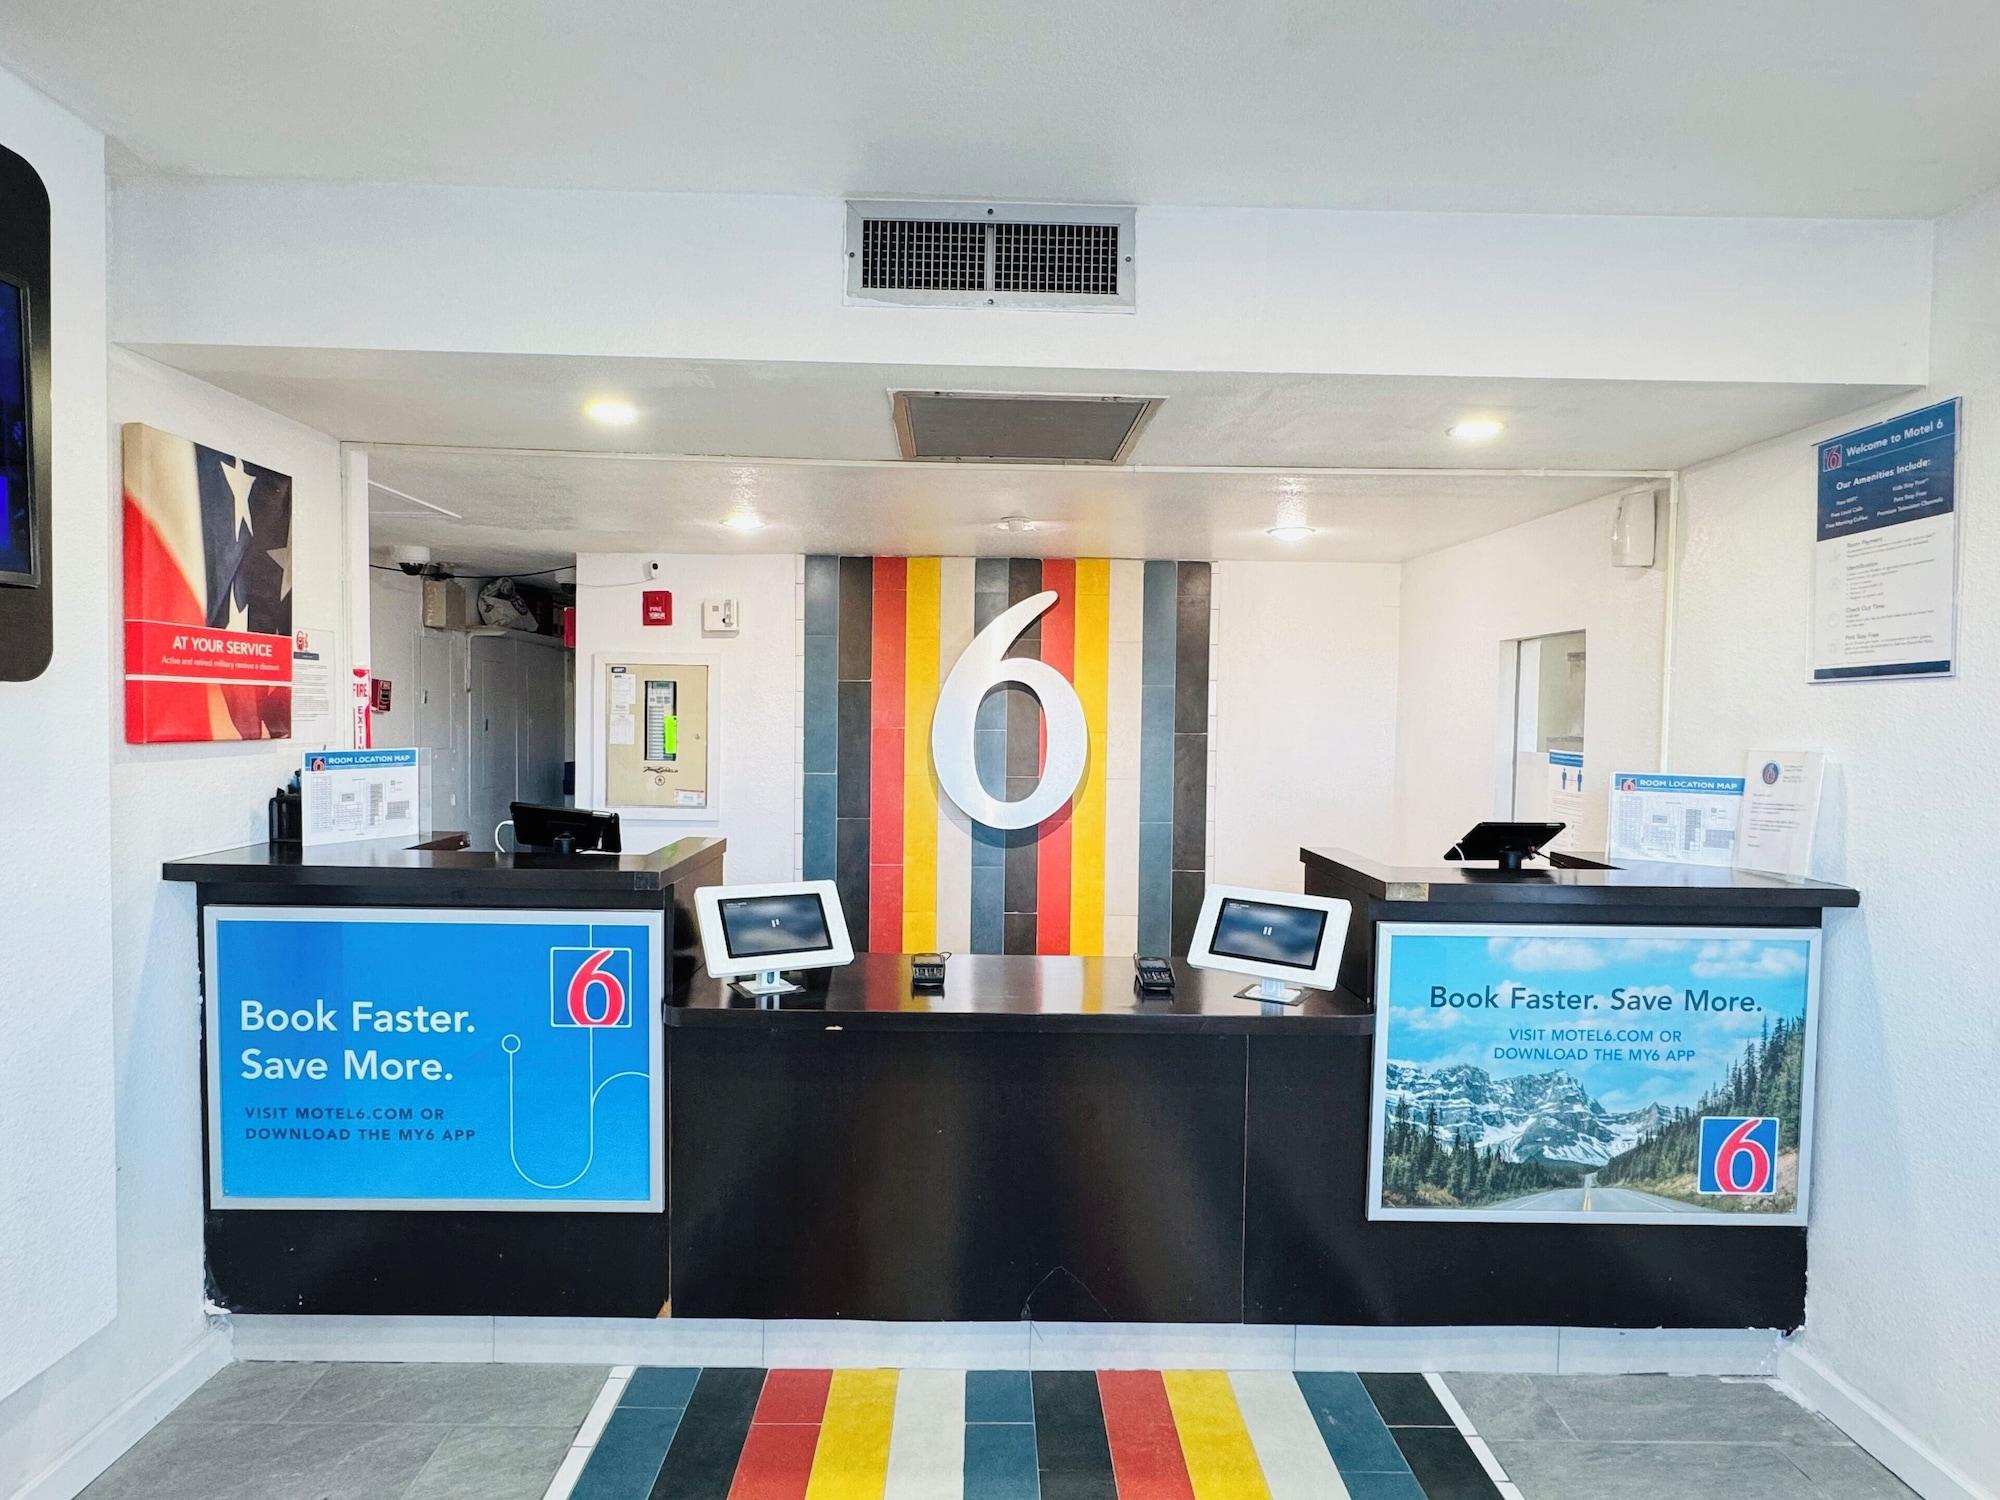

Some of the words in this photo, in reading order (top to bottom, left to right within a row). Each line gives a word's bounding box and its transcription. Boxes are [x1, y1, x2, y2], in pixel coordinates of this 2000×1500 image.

[1846, 437, 1888, 457] Welcome
[1891, 433, 1902, 442] to
[1904, 422, 1933, 439] Motel
[1937, 419, 1944, 429] 6
[1836, 480, 1851, 490] Our
[1853, 469, 1894, 486] Amenities
[1896, 459, 1931, 474] Include:
[173, 635, 188, 650] AT
[191, 636, 223, 653] YOUR
[226, 640, 273, 657] SERVICE
[932, 590, 1088, 830] 6
[328, 756, 353, 764] ROOM
[355, 756, 393, 764] LOCATION
[1640, 779, 1667, 787] ROOM
[1669, 780, 1716, 789] LOCATION
[1717, 782, 1737, 790] MAP
[567, 948, 626, 1027] 6
[1430, 985, 1499, 1009] Book
[1510, 986, 1599, 1010] Faster.
[1610, 987, 1673, 1011] Save
[1684, 988, 1762, 1012] More.
[240, 999, 337, 1032] Book
[352, 1000, 476, 1033] Faster.
[1509, 1028, 1547, 1041] VISIT
[1551, 1029, 1653, 1043] MOTEL6.COM
[1659, 1030, 1682, 1043] OR
[240, 1047, 328, 1081] Save
[344, 1049, 453, 1081] More.
[1494, 1047, 1588, 1060] DOWNLOAD
[1593, 1048, 1624, 1061] THE
[1629, 1048, 1660, 1061] MY6
[1665, 1049, 1695, 1062] APP
[245, 1107, 288, 1120] VISIT
[295, 1107, 414, 1120] MOTEL6.COM
[420, 1108, 444, 1120] OR
[245, 1128, 350, 1141] DOWNLOAD
[359, 1128, 391, 1141] THE
[398, 1128, 436, 1141] MY6
[443, 1128, 476, 1141] APP
[1714, 1118, 1771, 1193] 6
